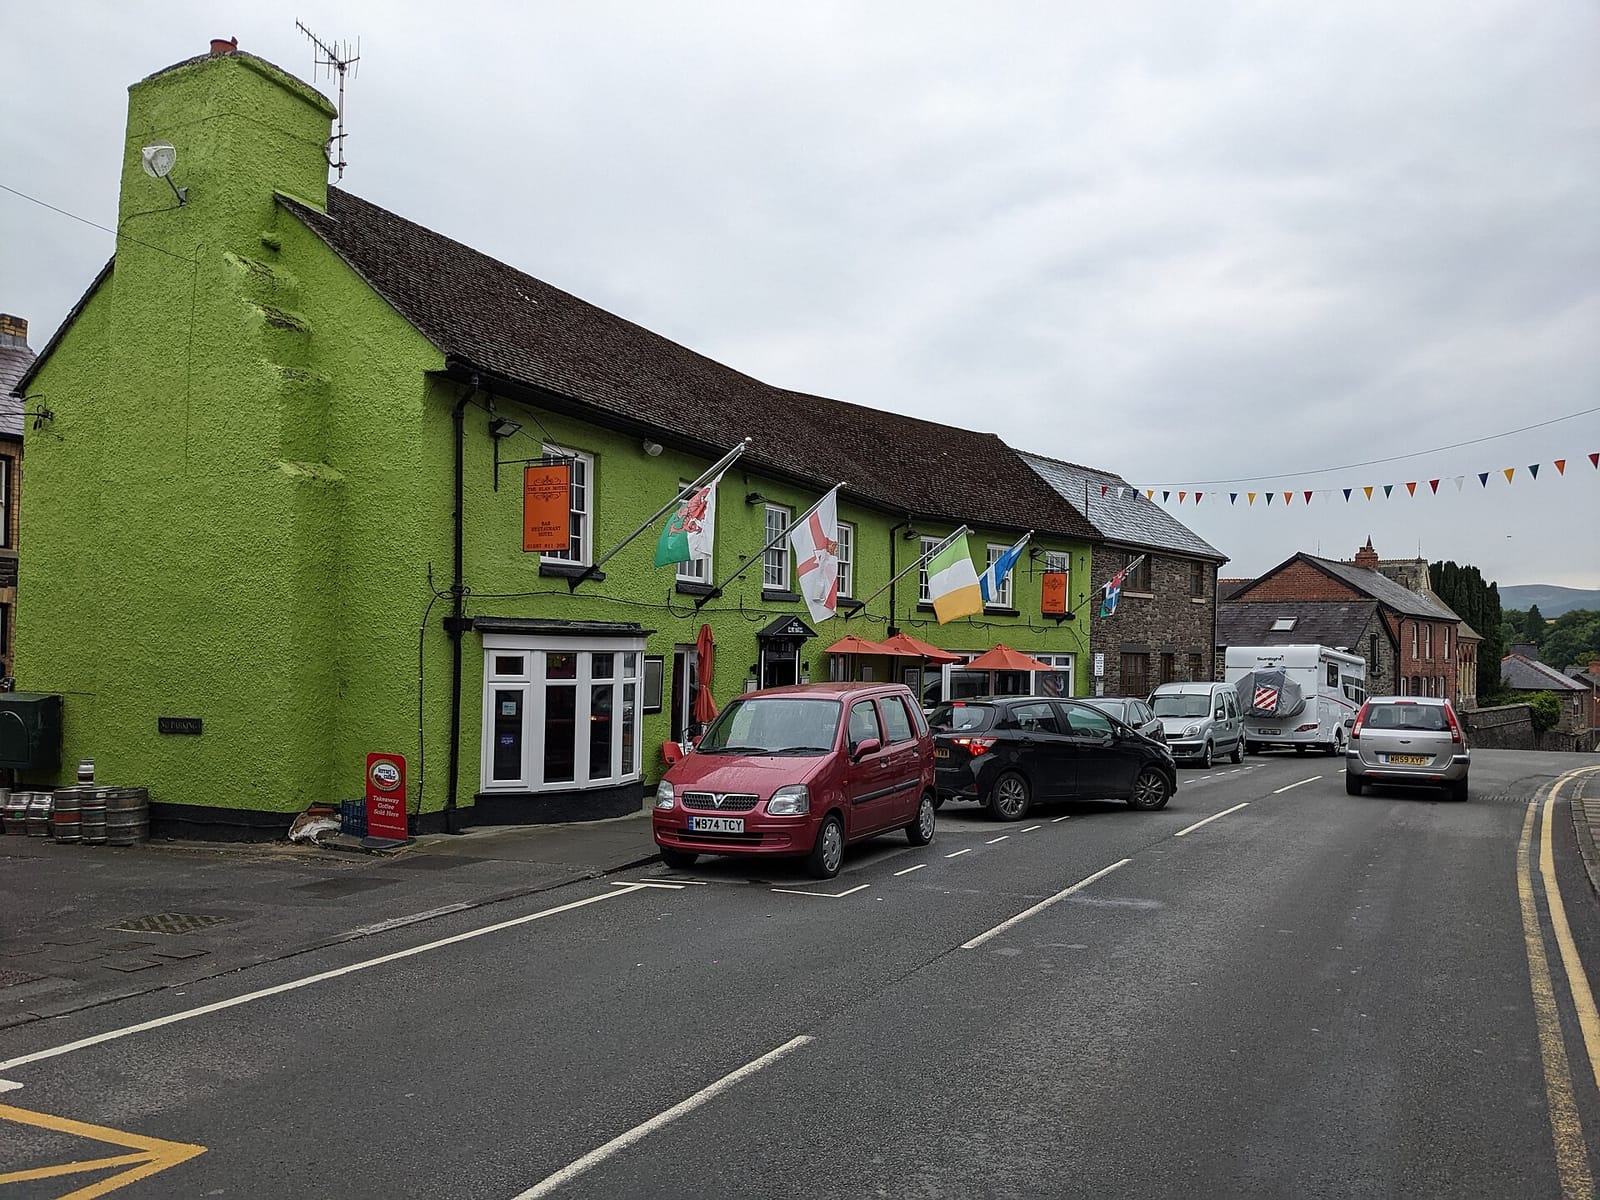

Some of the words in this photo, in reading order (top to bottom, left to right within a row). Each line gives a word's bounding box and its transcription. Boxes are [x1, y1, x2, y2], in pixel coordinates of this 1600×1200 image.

[373, 795, 399, 804] Takeaway
[694, 818, 720, 830] W974
[722, 820, 742, 831] TCY
